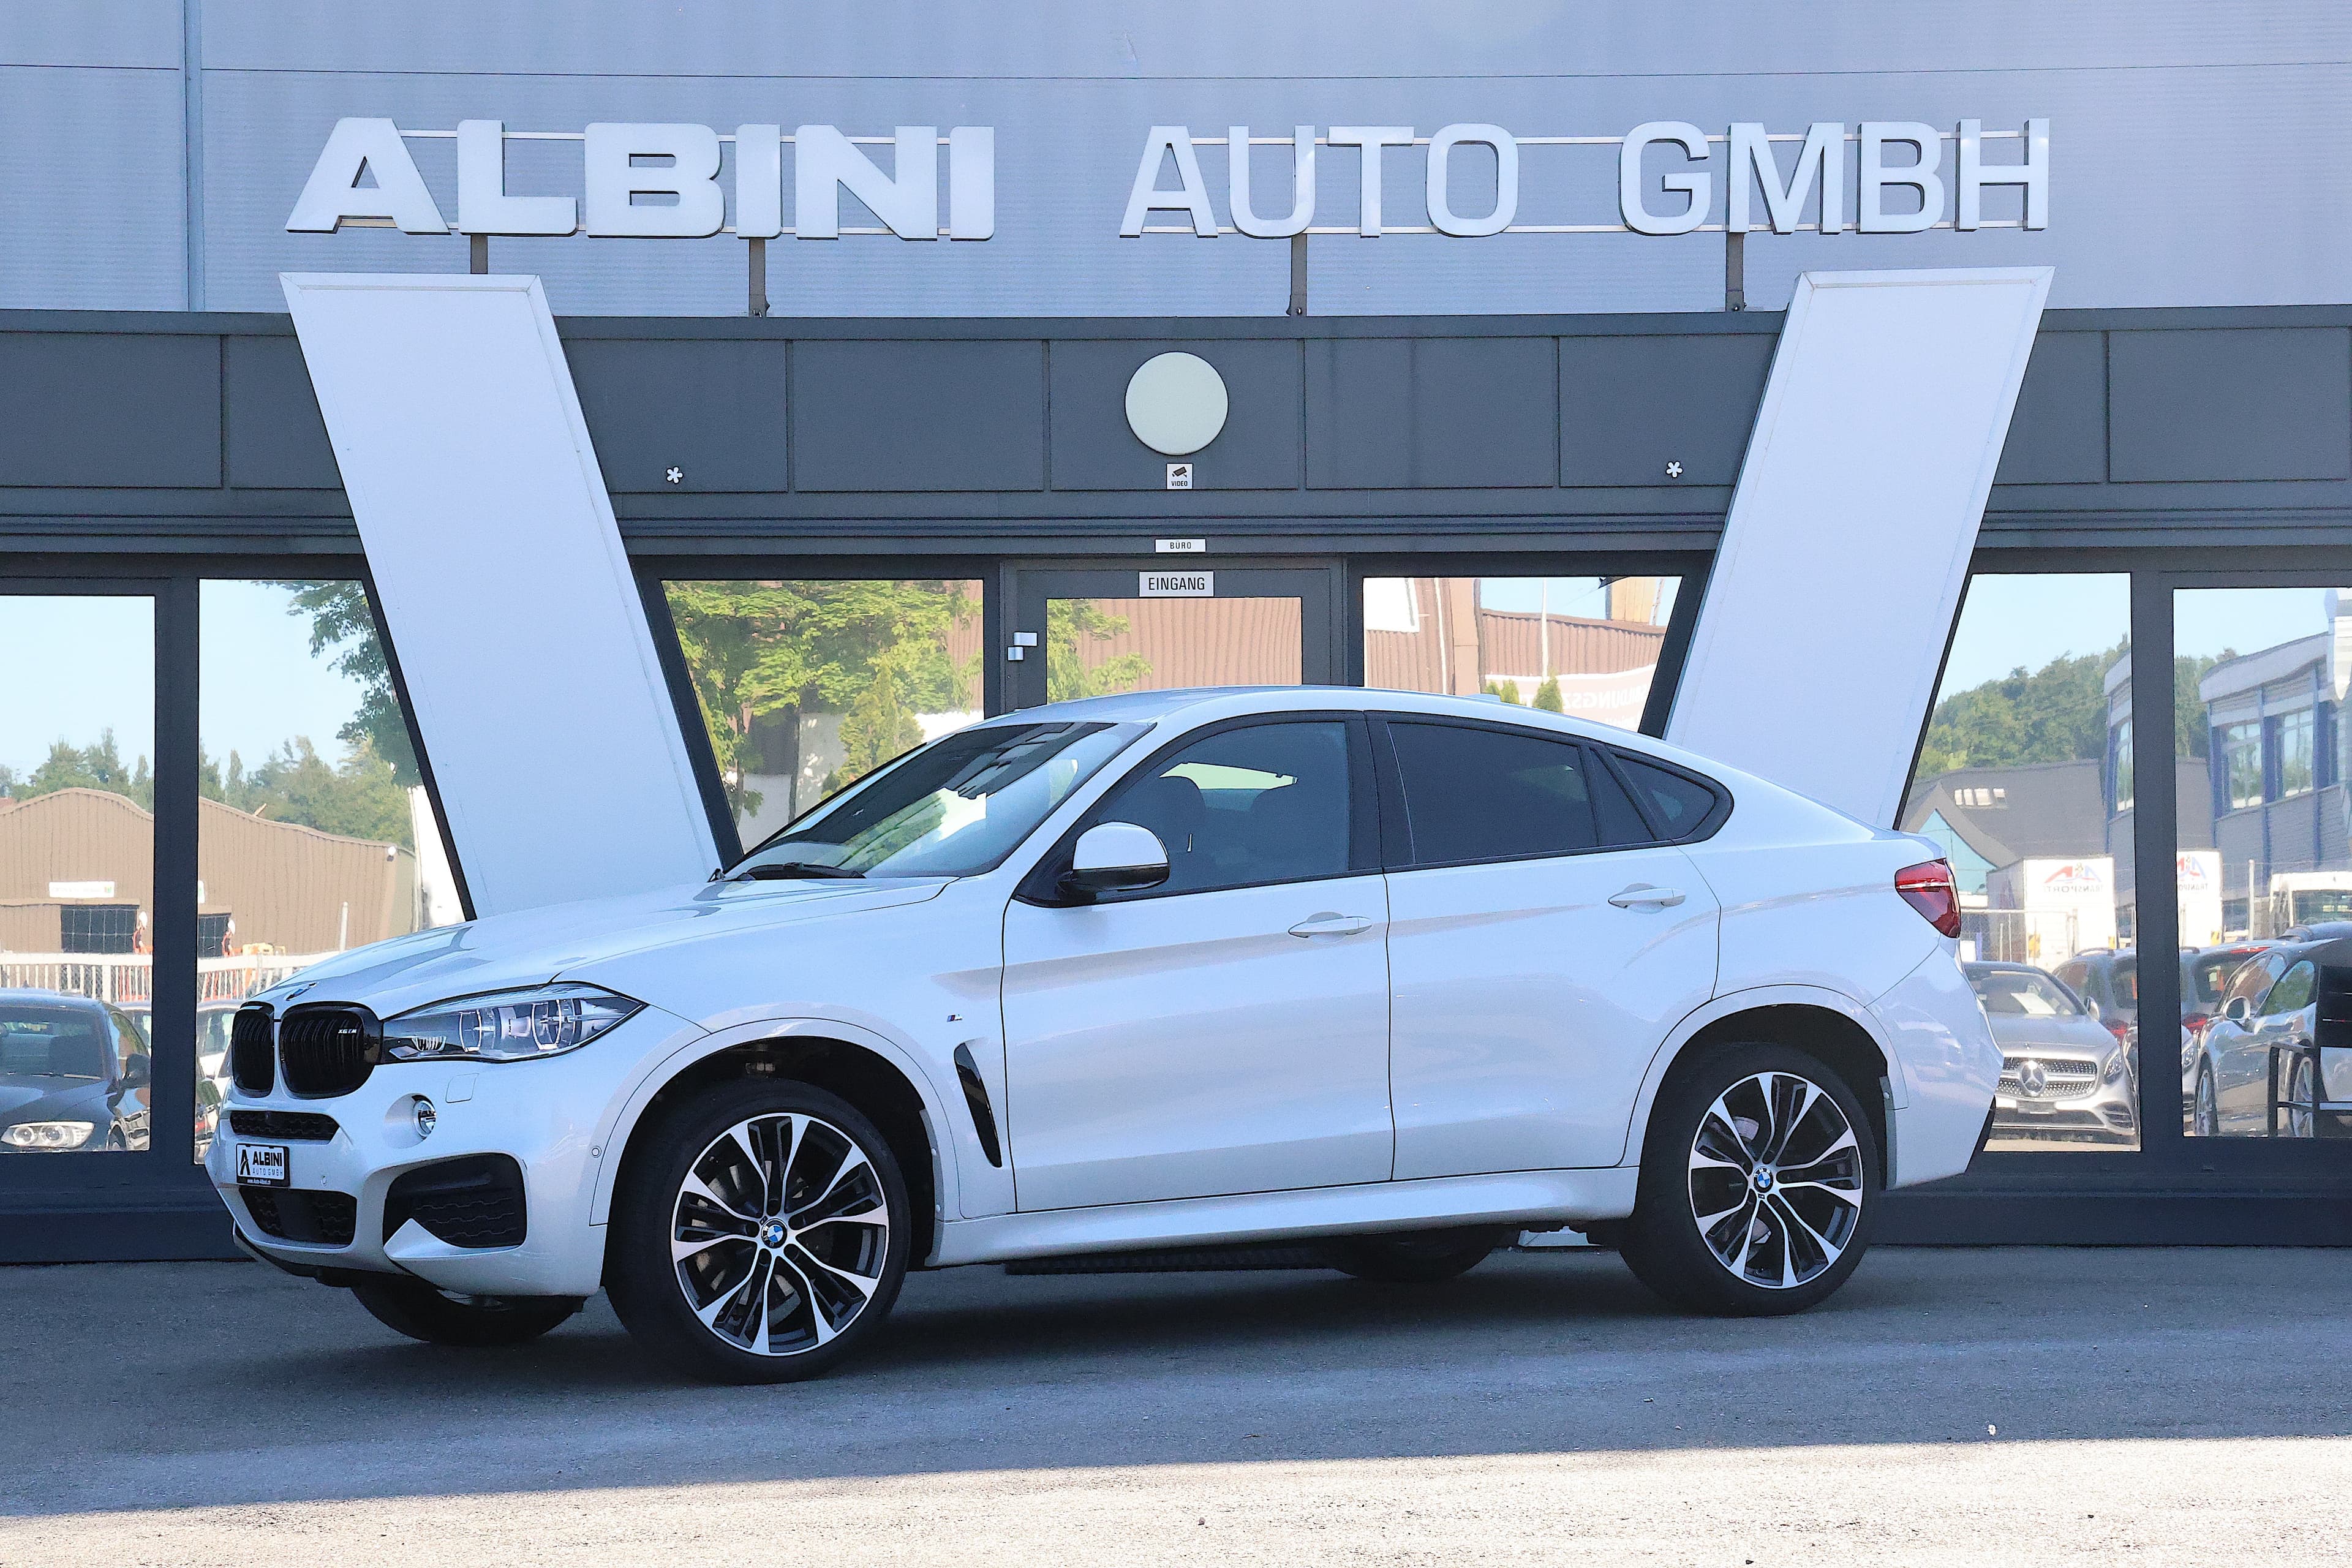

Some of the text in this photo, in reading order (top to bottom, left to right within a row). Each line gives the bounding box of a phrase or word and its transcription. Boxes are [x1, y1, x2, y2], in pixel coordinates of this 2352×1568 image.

[285, 117, 2050, 241] ALBINI AUTO GMBH
[1170, 541, 1191, 549] BÜRO
[1148, 577, 1205, 590] EINGANG
[252, 1151, 282, 1167] ALBINI
